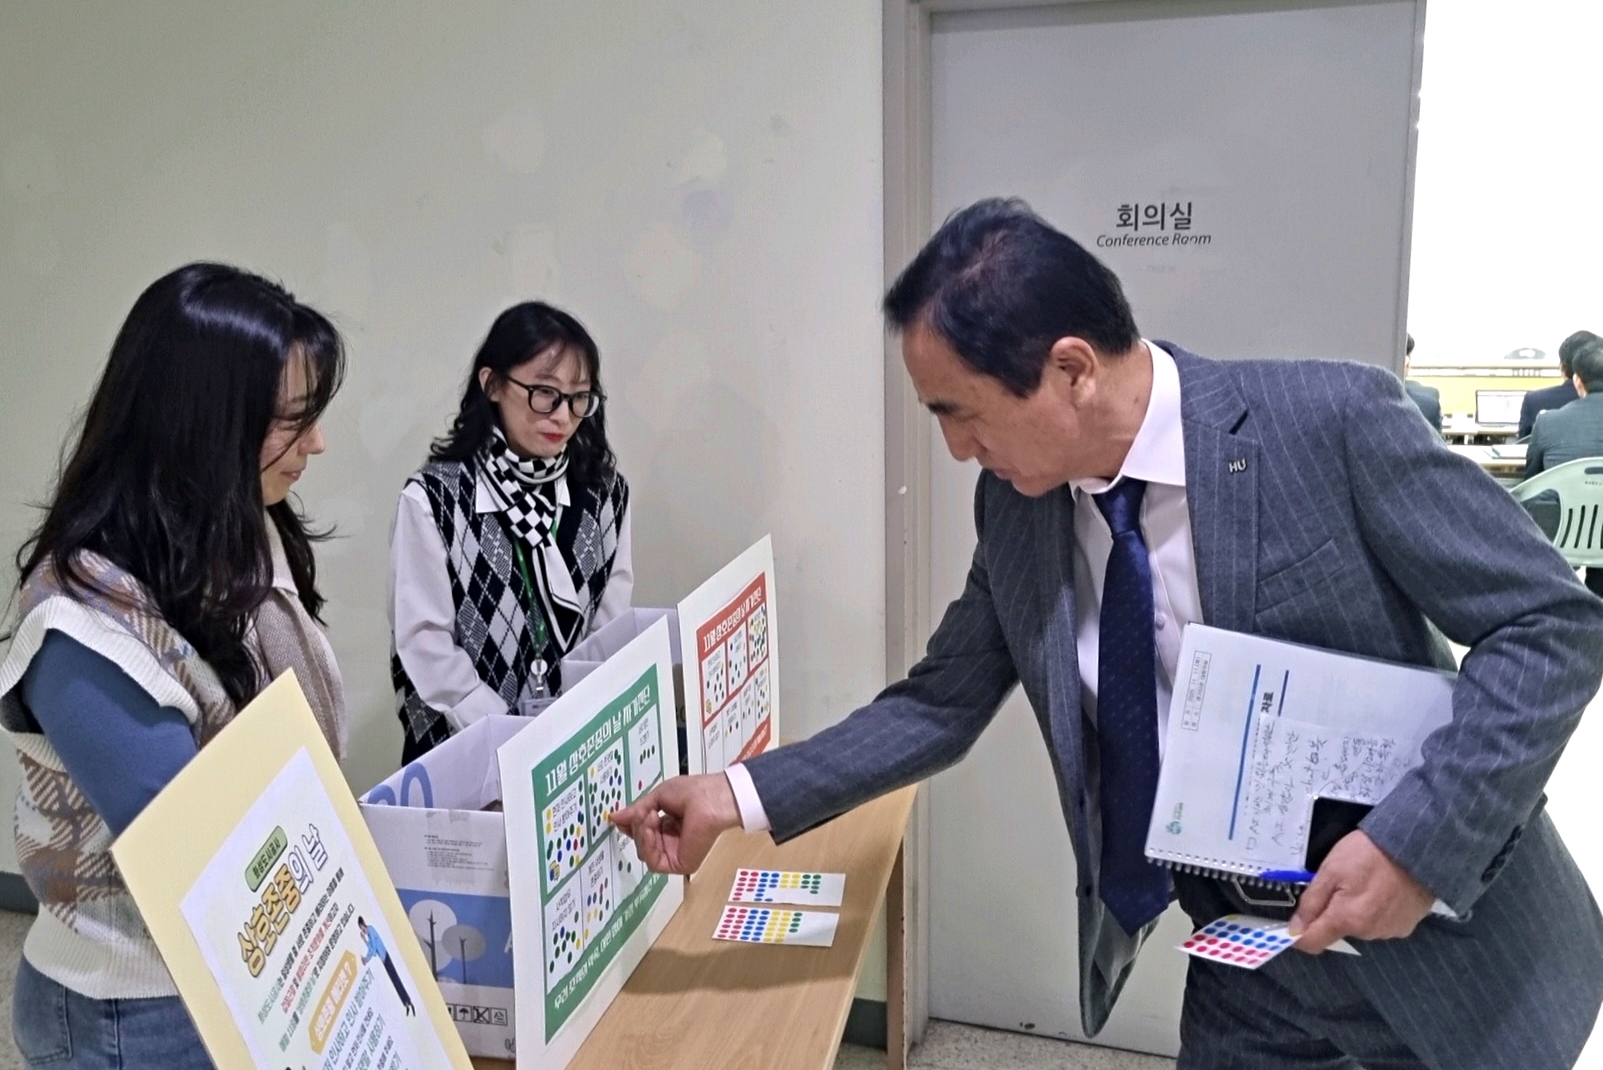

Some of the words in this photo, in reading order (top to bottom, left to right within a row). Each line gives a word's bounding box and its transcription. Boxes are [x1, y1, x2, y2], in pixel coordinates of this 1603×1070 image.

[1116, 202, 1192, 231] 회의실
[1096, 234, 1170, 247] Conference
[1172, 233, 1212, 245] Room
[1261, 692, 1273, 712] 자료
[545, 760, 567, 795] 11월
[569, 719, 611, 774] 상호존중의
[612, 711, 621, 733] 날
[238, 846, 312, 976] 상호존중의
[301, 823, 327, 871] 날
